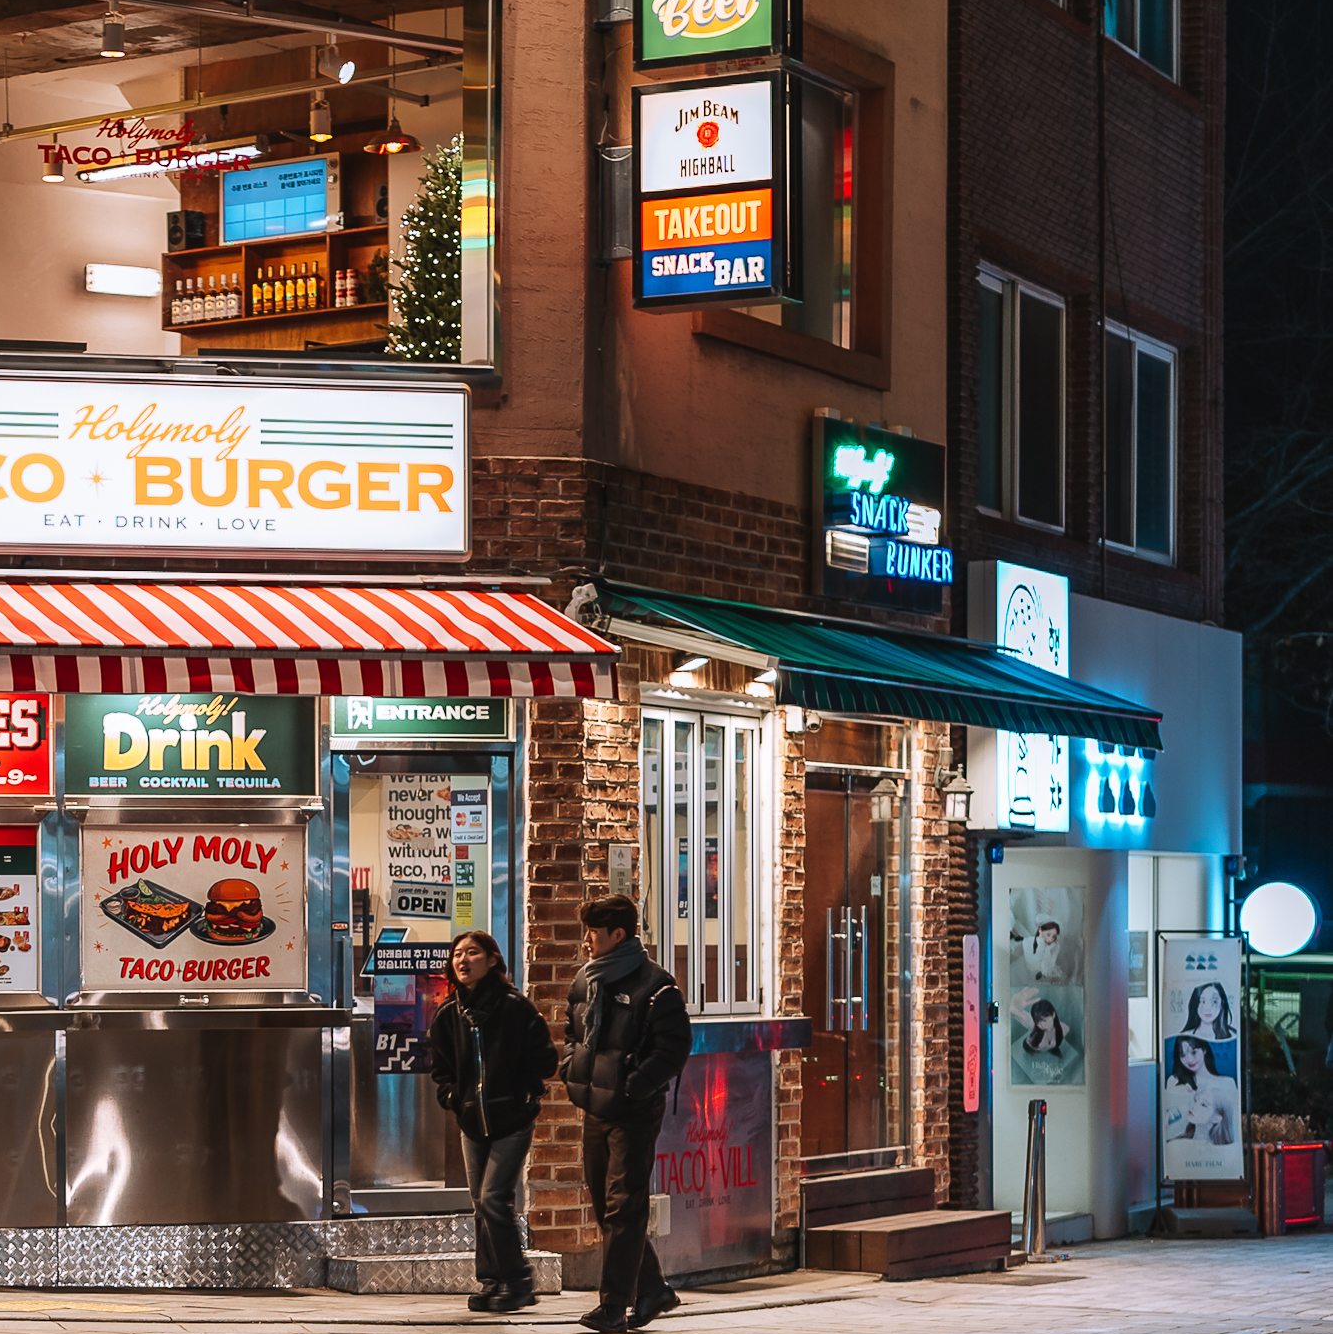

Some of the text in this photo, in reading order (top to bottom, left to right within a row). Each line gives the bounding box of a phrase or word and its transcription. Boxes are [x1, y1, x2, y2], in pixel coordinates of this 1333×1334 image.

[96, 117, 197, 150] Holymoly
[37, 144, 251, 172] TACO BURGER
[680, 154, 735, 178] HIGHBALL
[654, 200, 762, 241] TAKEOUT
[651, 251, 765, 286] SNACK BAR
[68, 402, 252, 461] Holymoly
[133, 456, 454, 513] BURGER
[43, 514, 277, 532] EAT DRINK LOVE
[850, 491, 909, 533] SNACK
[886, 540, 953, 583] BUNKER
[135, 694, 238, 726] Holymoly!
[376, 704, 490, 721] ENTRANCE
[102, 710, 267, 772] Drink
[89, 776, 128, 788] BEER
[139, 776, 209, 788] COCKTAIL
[388, 789, 434, 802] never
[457, 793, 482, 803] We Accept
[388, 805, 451, 824] thought
[422, 827, 432, 838] a
[107, 834, 279, 885] HOLY MOLY
[388, 842, 448, 858] without
[351, 867, 371, 890] XIT
[388, 862, 427, 880] taco,
[397, 895, 447, 914] OPEN
[456, 891, 472, 902] POSTED
[377, 949, 412, 958] 아래층에
[413, 949, 431, 958] 추가
[377, 960, 414, 969] 있습니다.
[119, 955, 271, 983] TACO BURGER
[376, 1033, 397, 1051] B1
[685, 1118, 734, 1150] Holymoly!
[656, 1145, 758, 1195] TACO VILL
[685, 1195, 731, 1210] EAT DRINK LOVE
